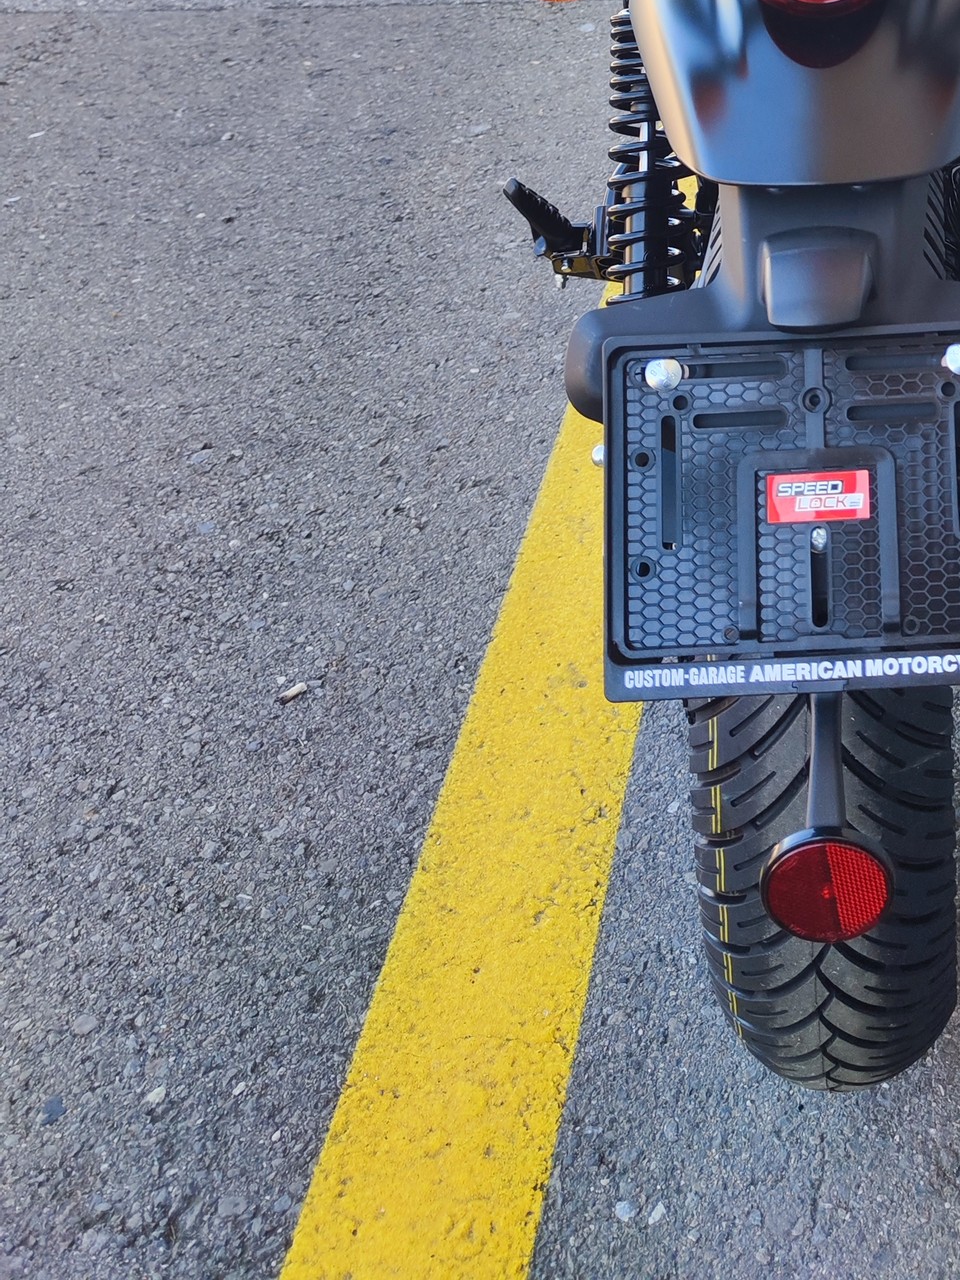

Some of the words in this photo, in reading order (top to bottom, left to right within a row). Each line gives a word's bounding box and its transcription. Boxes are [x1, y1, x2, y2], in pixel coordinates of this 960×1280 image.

[777, 480, 843, 496] SPEED
[797, 496, 848, 510] LOCK
[624, 665, 746, 689] CUSTOM-GARAGE
[749, 660, 863, 682] AMERICAN
